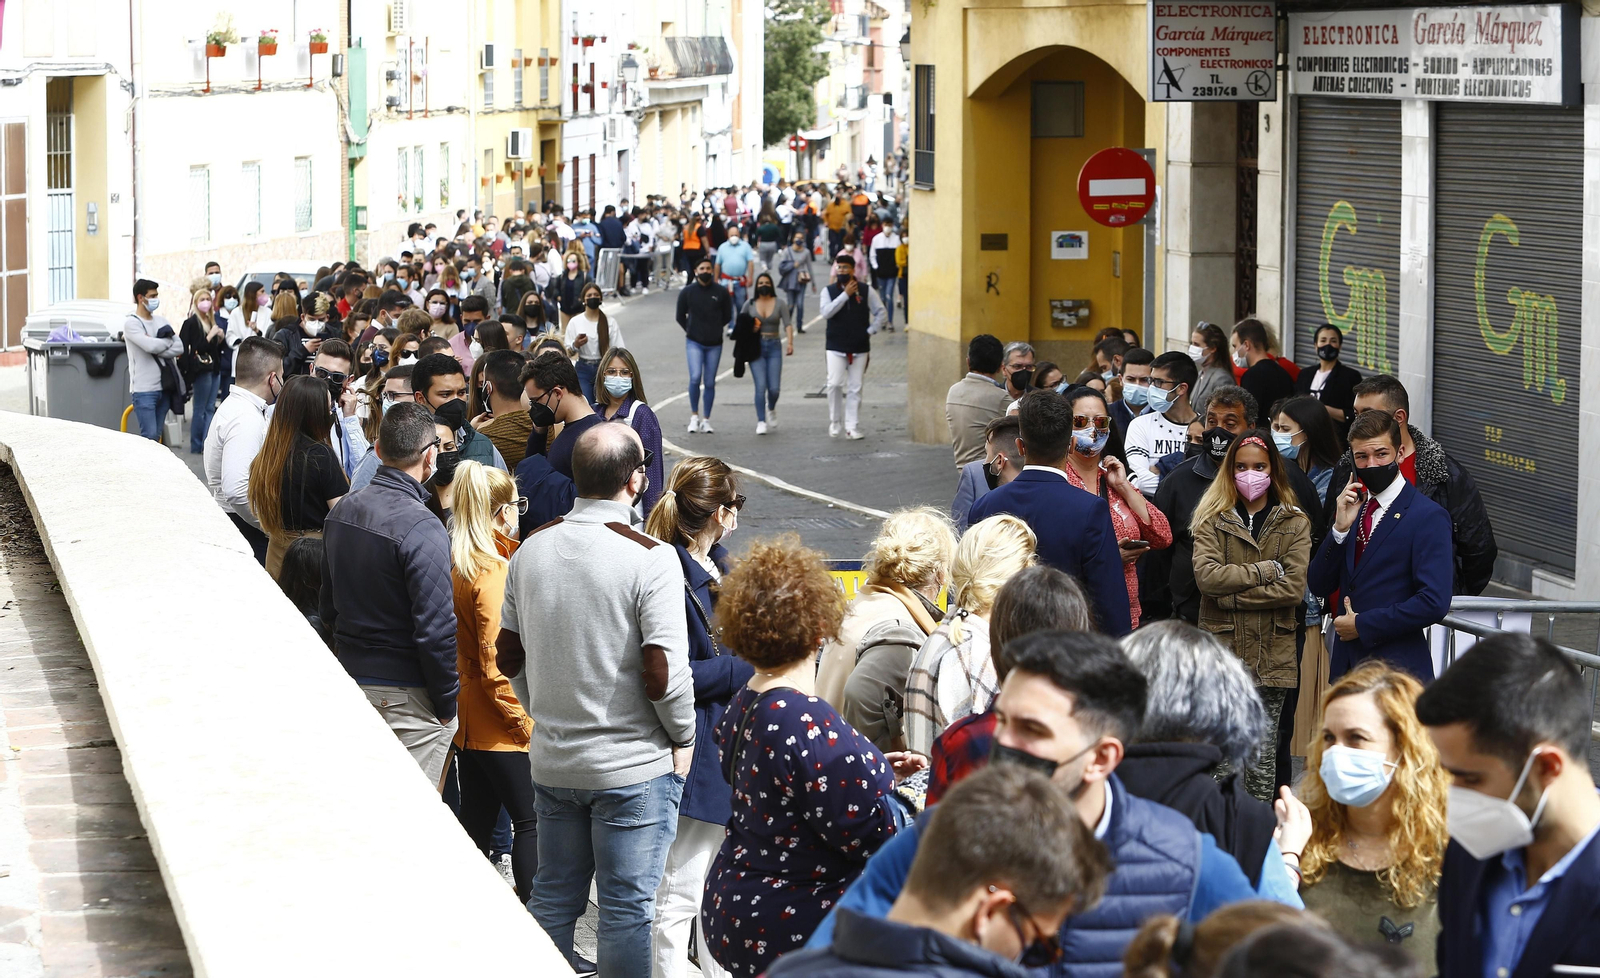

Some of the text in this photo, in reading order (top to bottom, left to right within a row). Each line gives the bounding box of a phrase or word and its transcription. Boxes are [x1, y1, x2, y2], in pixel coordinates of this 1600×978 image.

[1156, 5, 1274, 18] ELECTRONICA
[1156, 25, 1274, 45] García Márquez
[1303, 11, 1543, 54] ELECTRONICA García Márquez
[1156, 47, 1231, 57] COMPONENTES
[1200, 59, 1274, 69] ELECTRONICOS
[1297, 56, 1350, 73] COMPONENTES
[1352, 56, 1409, 74] ELECTRONICOS
[1423, 57, 1458, 75] SONIDO
[1472, 57, 1552, 76] AMPLIFICADORES
[1192, 86, 1238, 96] 2391748
[1312, 76, 1345, 92] ANTENAS
[1348, 77, 1394, 94] COLECTIVAS
[1414, 78, 1460, 95] PORTEROS
[1463, 79, 1532, 98] ELECTRONICOS
